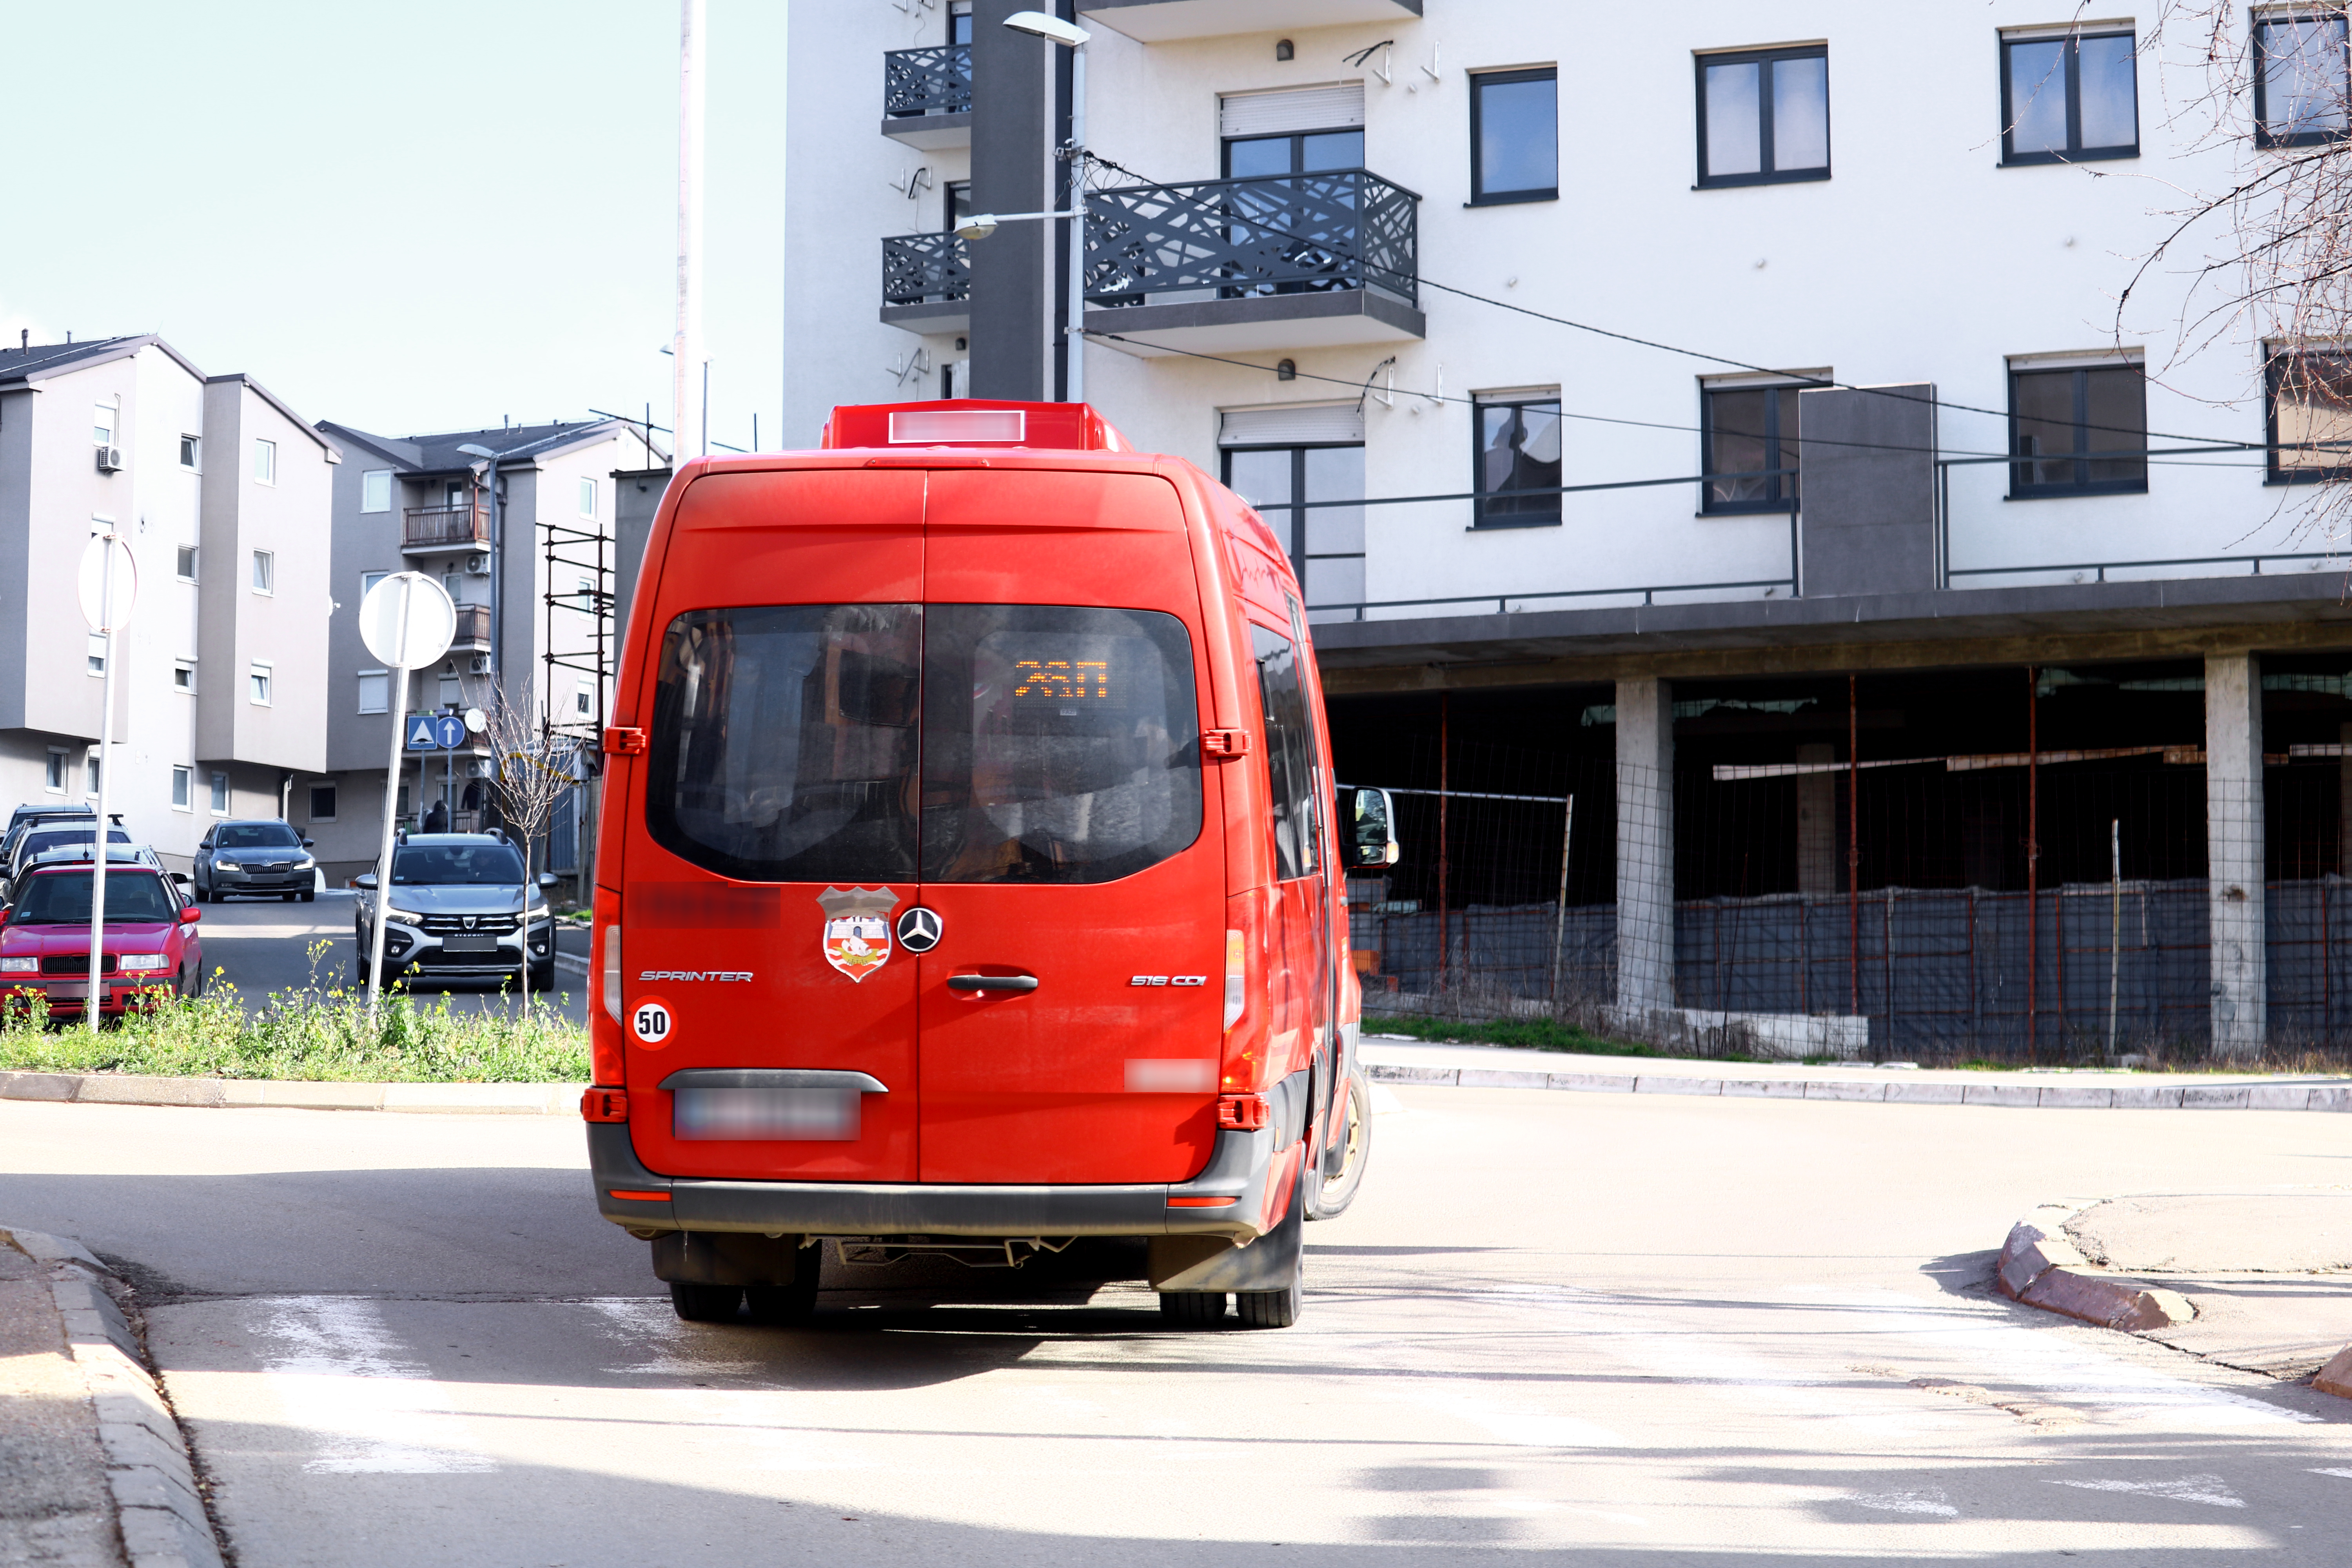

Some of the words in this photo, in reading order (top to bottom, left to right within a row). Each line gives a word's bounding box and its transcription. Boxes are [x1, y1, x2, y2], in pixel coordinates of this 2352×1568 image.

[639, 971, 753, 982] SPRINTER
[1131, 975, 1169, 986] 516
[1171, 975, 1207, 986] CDI
[638, 1011, 666, 1034] 50
